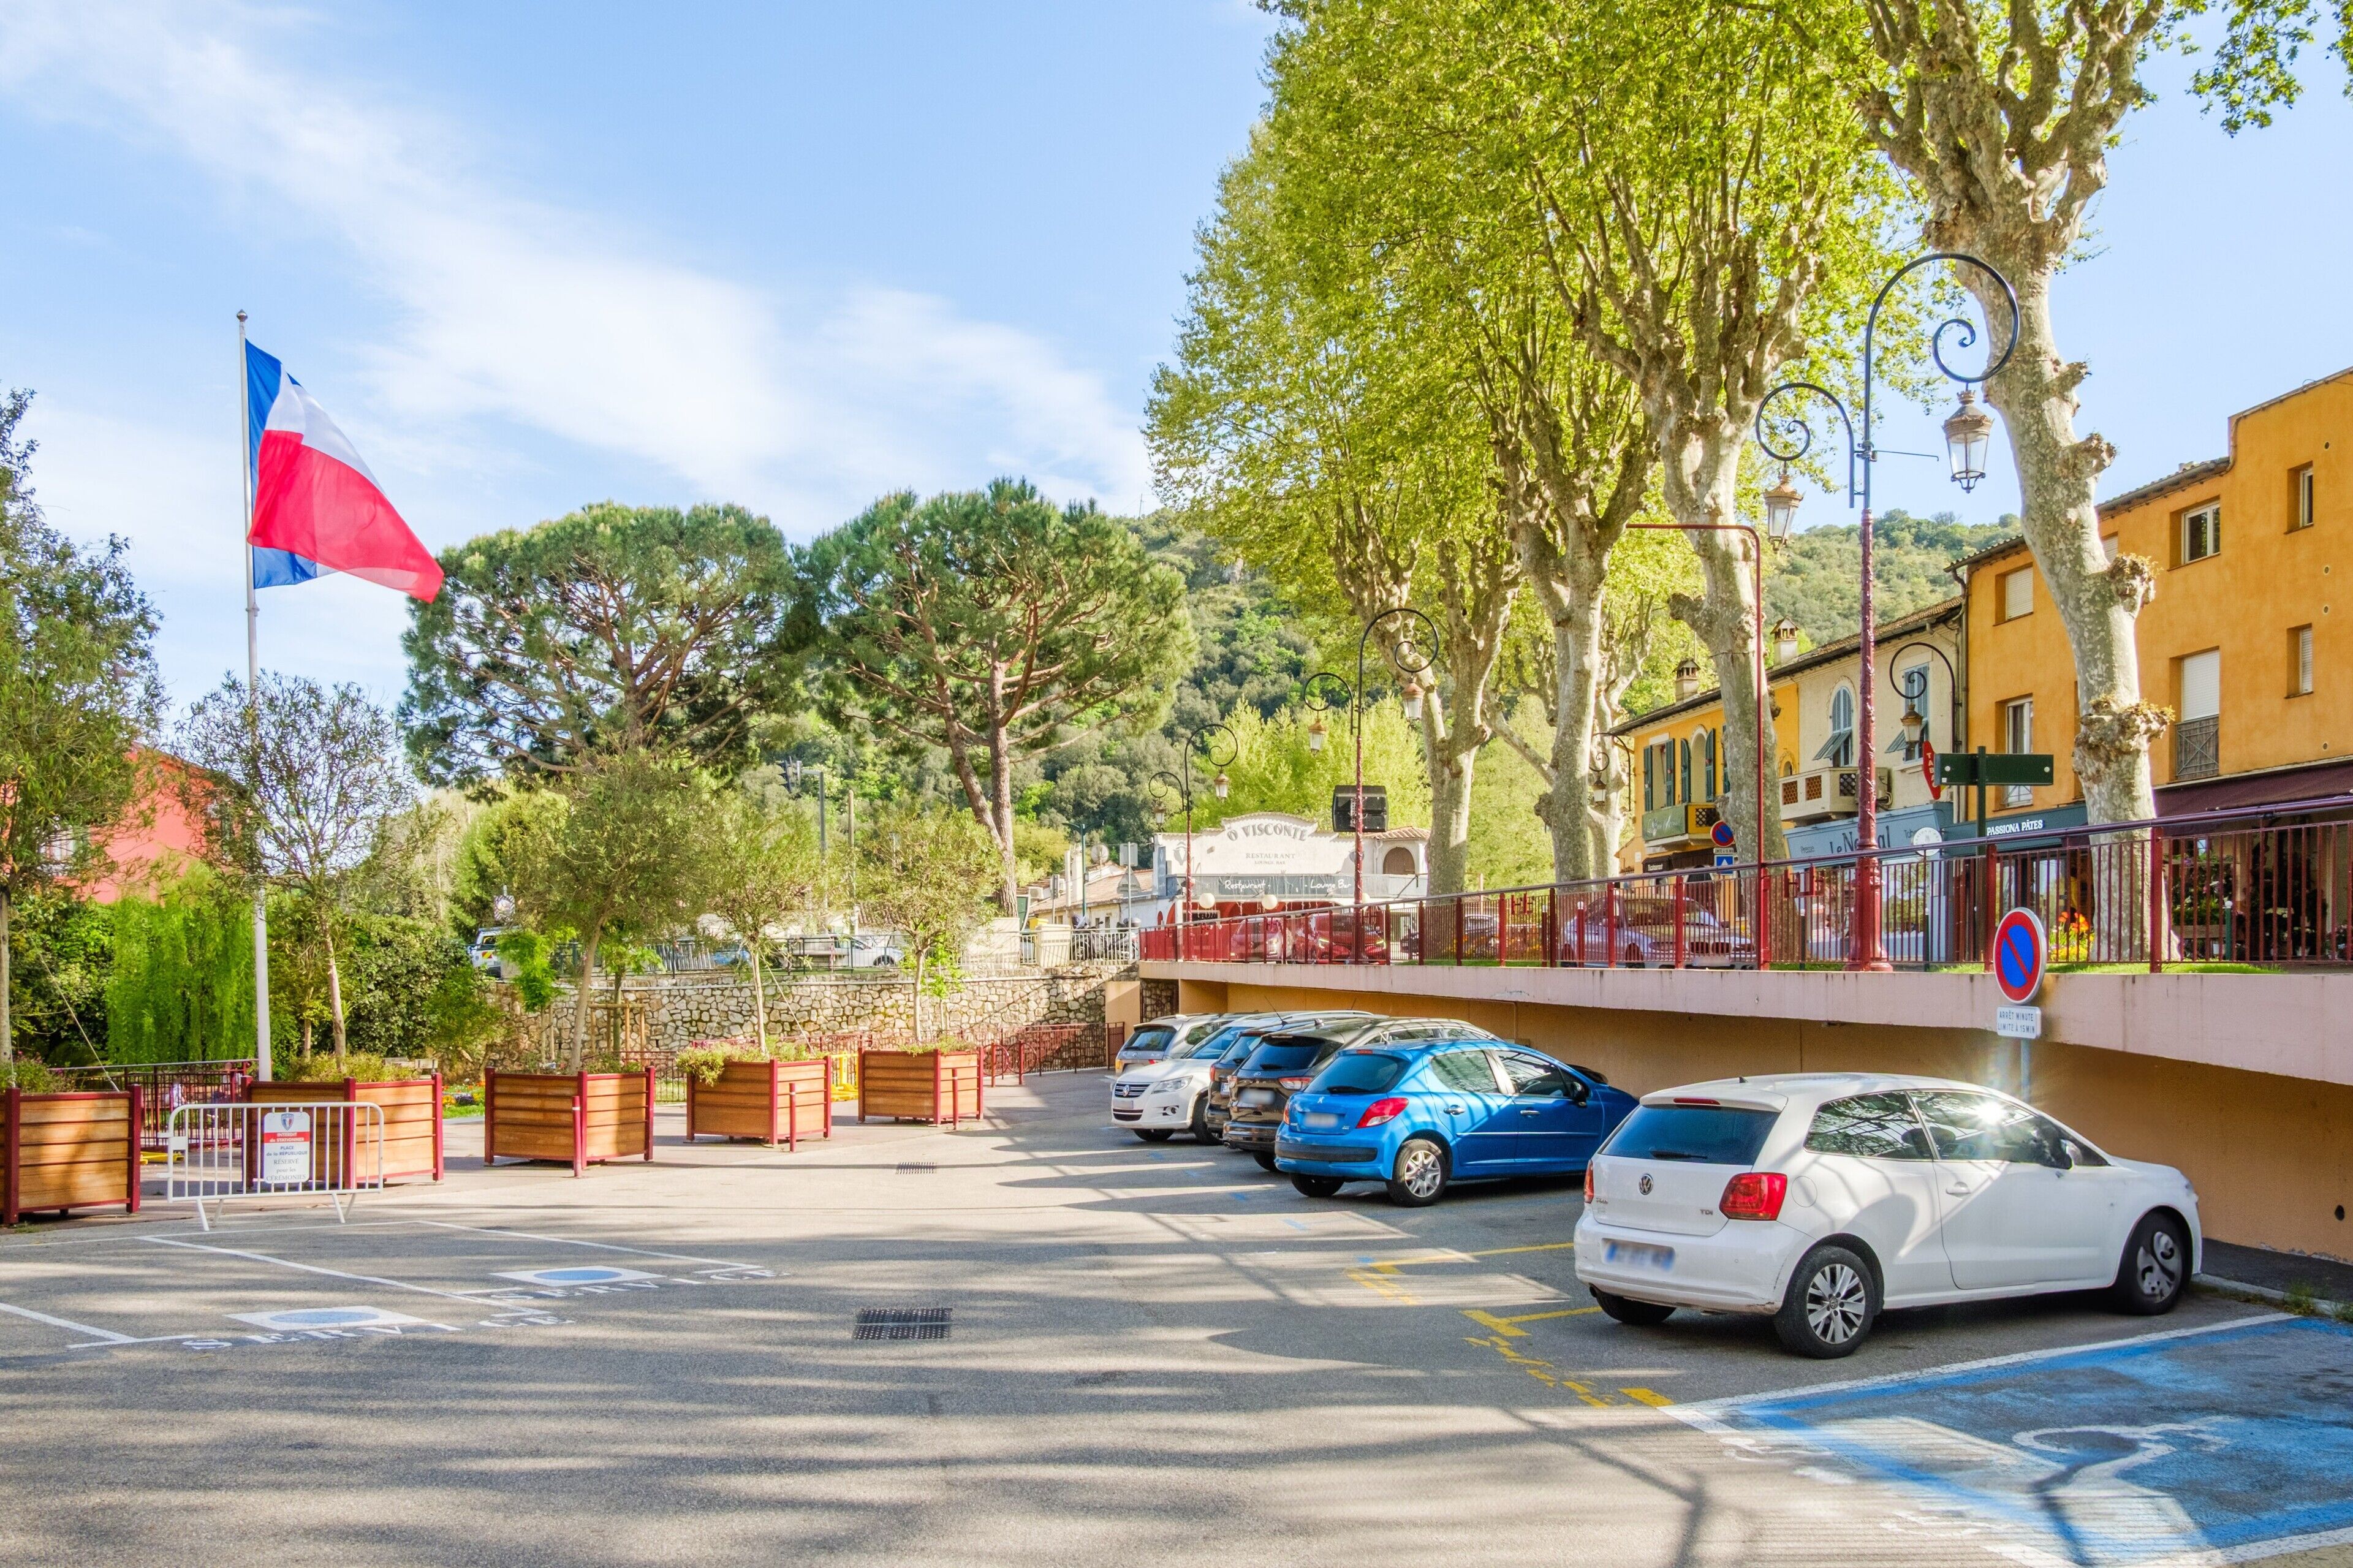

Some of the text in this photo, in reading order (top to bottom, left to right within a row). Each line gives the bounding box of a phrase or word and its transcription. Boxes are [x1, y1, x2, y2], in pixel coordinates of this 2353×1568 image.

[1241, 822, 1307, 842] VISCONTE
[1987, 819, 2044, 836] PASSIONA PÂTES
[1224, 879, 1351, 892] Restaurant Lounge Bar
[1999, 1010, 2034, 1021] ARRÊT MINUTE
[490, 1269, 792, 1301] SERVICE
[181, 1314, 577, 1350] SERVICE
